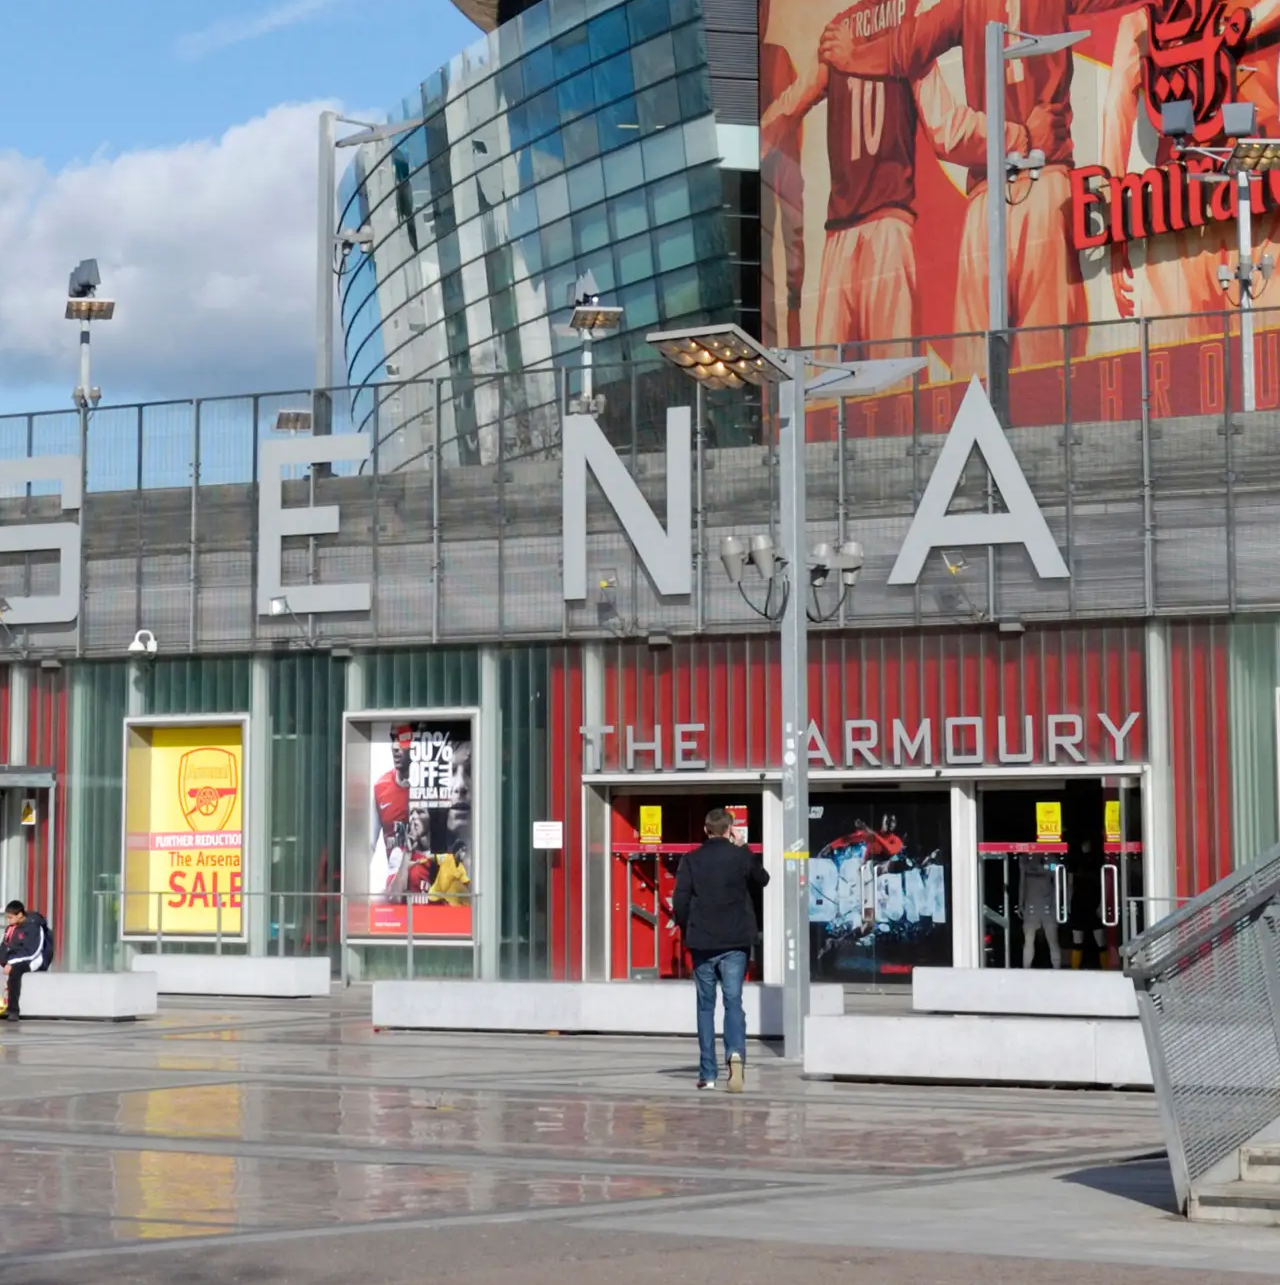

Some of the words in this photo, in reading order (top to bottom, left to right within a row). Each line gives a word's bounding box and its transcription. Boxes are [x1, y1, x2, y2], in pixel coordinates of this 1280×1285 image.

[847, 76, 885, 162] 10
[409, 730, 453, 762] 50%
[579, 723, 707, 771] THE
[806, 712, 1141, 767] ARMOURY
[408, 761, 439, 788] OFF
[155, 835, 194, 848] FURTHER
[167, 851, 192, 867] The
[167, 870, 242, 908] SALE
